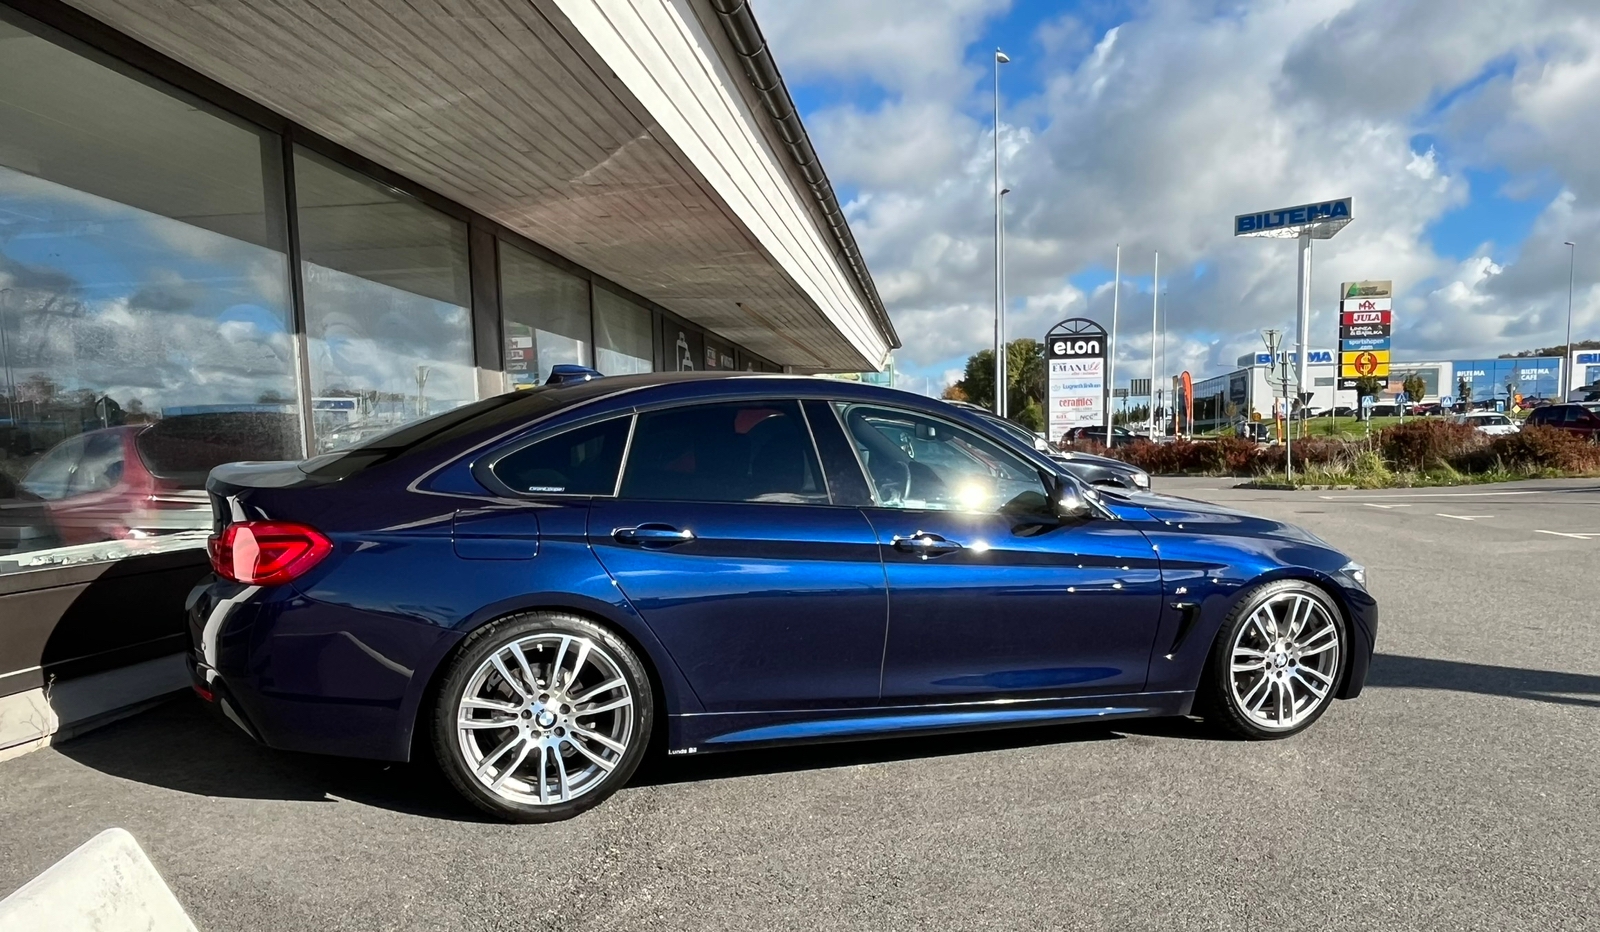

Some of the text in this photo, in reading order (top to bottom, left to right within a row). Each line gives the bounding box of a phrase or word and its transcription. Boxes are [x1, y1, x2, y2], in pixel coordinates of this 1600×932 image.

[1237, 201, 1349, 232] BILTEMA
[1359, 300, 1376, 310] MAX
[1354, 314, 1380, 322] JULA
